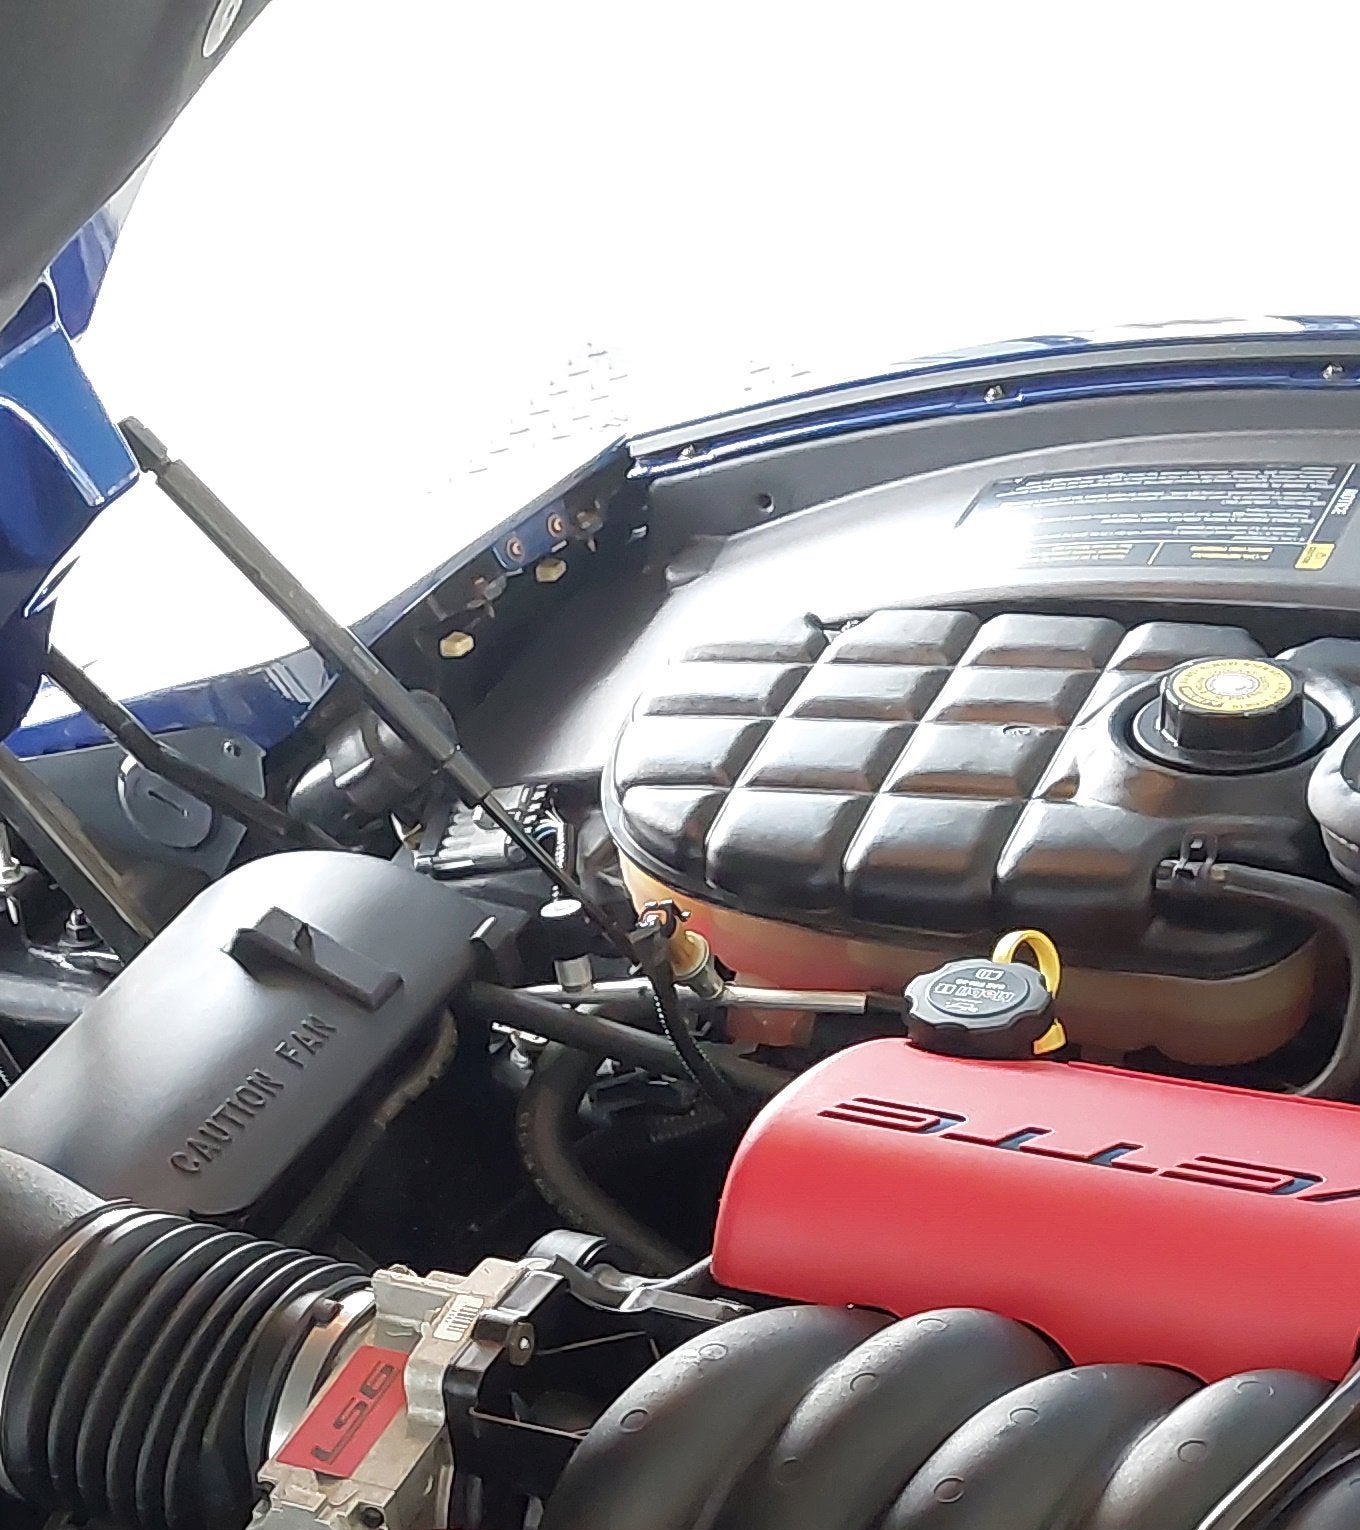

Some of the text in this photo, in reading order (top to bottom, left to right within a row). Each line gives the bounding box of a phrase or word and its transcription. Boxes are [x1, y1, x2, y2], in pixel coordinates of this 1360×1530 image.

[171, 1014, 337, 1173] CAUTION FAN
[311, 1361, 397, 1464] LS6
